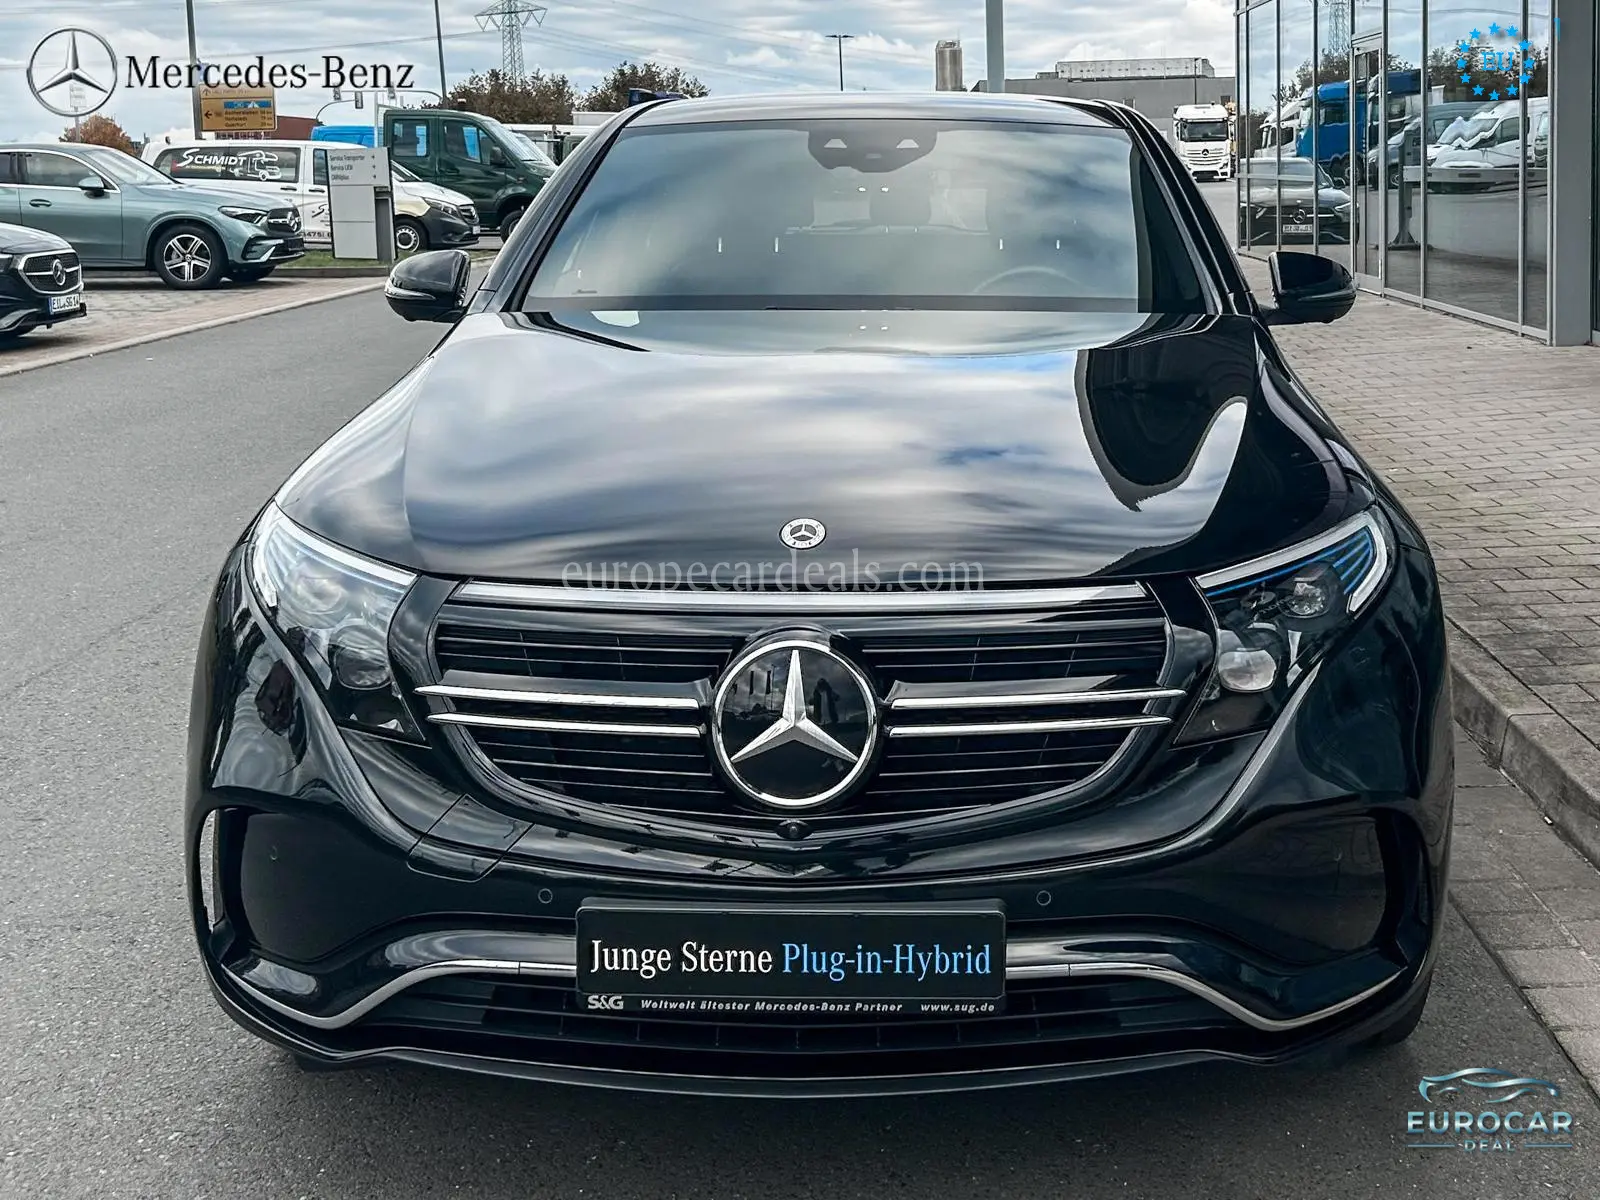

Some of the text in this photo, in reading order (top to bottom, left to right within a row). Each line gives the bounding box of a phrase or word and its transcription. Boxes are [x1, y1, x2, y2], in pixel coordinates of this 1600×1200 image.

[176, 148, 247, 167] SCHMIDT
[590, 939, 991, 982] Junge Sterne Plug-in-Hybrid
[587, 994, 624, 1010] S&G
[754, 1001, 851, 1012] Mercedes-Benz
[855, 1002, 903, 1012] Partner
[920, 1003, 995, 1013] www.sug.de
